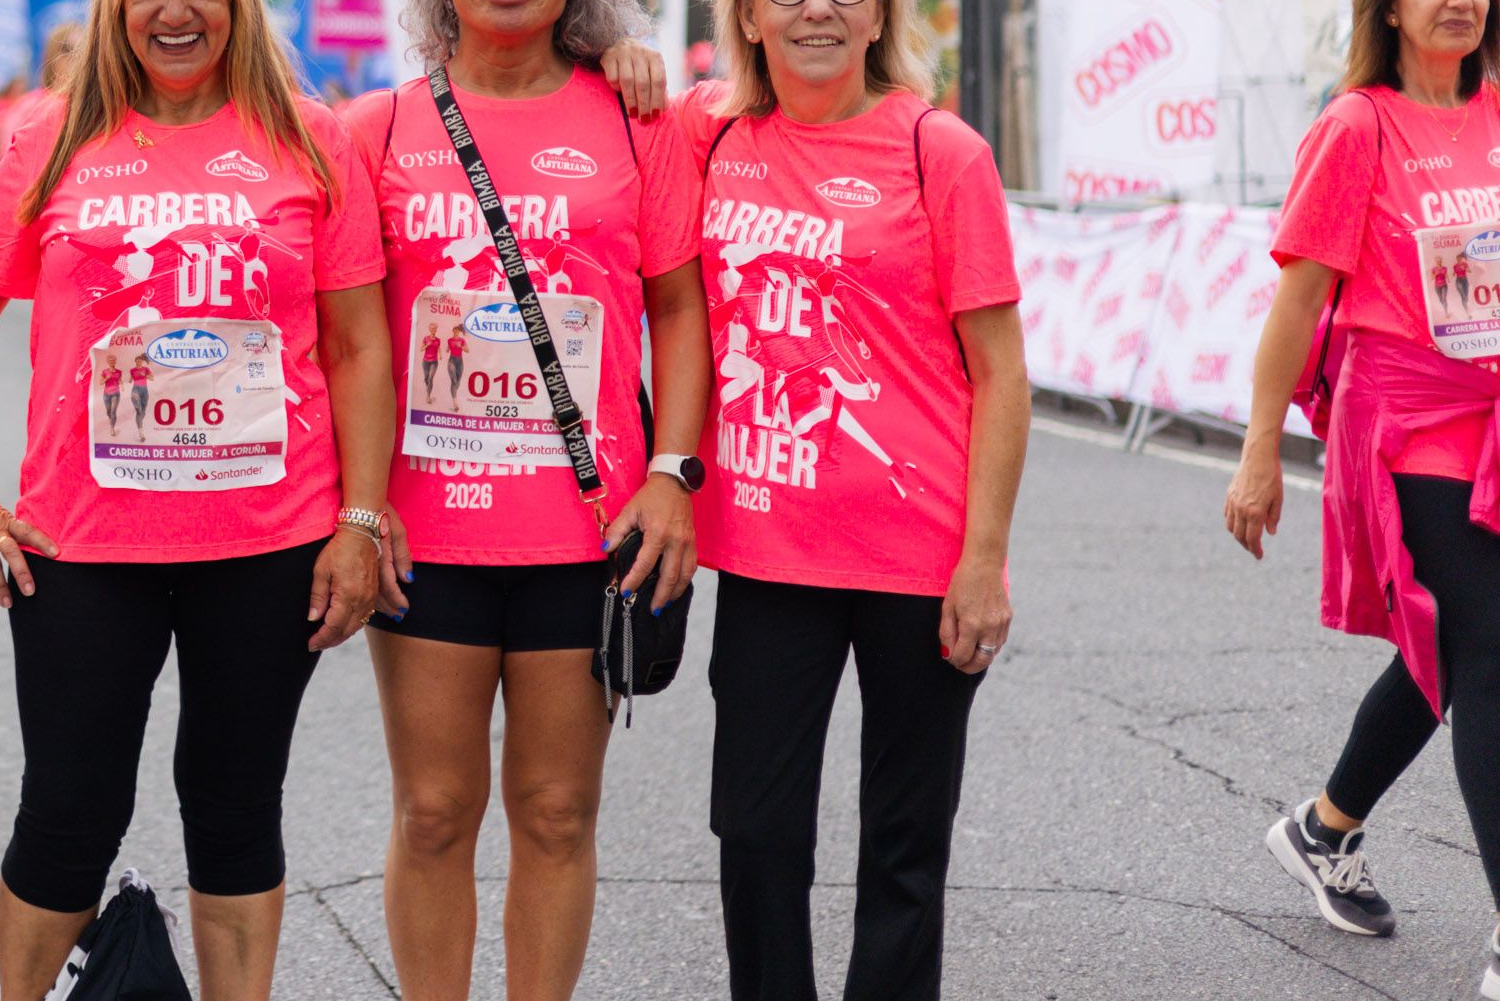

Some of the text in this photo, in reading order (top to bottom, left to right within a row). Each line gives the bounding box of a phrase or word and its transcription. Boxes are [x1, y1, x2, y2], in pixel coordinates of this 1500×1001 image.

[1075, 19, 1172, 107] COSMO
[442, 103, 473, 150] BIMBA
[1156, 98, 1218, 143] COS
[77, 160, 148, 184] OYSHO
[211, 161, 264, 179] ASTURIANA
[537, 156, 593, 174] ASTURIANA
[467, 159, 501, 211] BIMBA
[821, 185, 876, 203] ASTURIANA
[78, 191, 261, 230] CARRERA
[702, 198, 844, 266] CARRERA
[493, 225, 526, 278] BIMBA
[175, 240, 237, 307] DE
[430, 303, 461, 318] SUMA
[756, 267, 816, 338] DE
[520, 292, 551, 346] BIMBA
[154, 344, 223, 360] ASTURIANA
[1451, 337, 1497, 351] OYSHO
[468, 371, 538, 400] 016
[154, 398, 224, 426] 016
[485, 405, 519, 418] 5023
[754, 368, 792, 432] LA
[424, 414, 464, 428] CARRERA
[466, 418, 477, 429] DE
[479, 419, 491, 429] LA
[493, 420, 525, 431] MUJER
[533, 422, 540, 431] A
[109, 444, 266, 459] CARRERA DE LA MUJER A CORUÑA
[173, 433, 207, 445] 4648
[426, 434, 483, 452] OYSHO
[565, 426, 596, 480] BIMBA
[716, 412, 819, 489] MUJER
[114, 466, 172, 481] OYSHO
[211, 466, 263, 480] Santander
[445, 483, 493, 509] 2026
[734, 480, 771, 513] 2026
